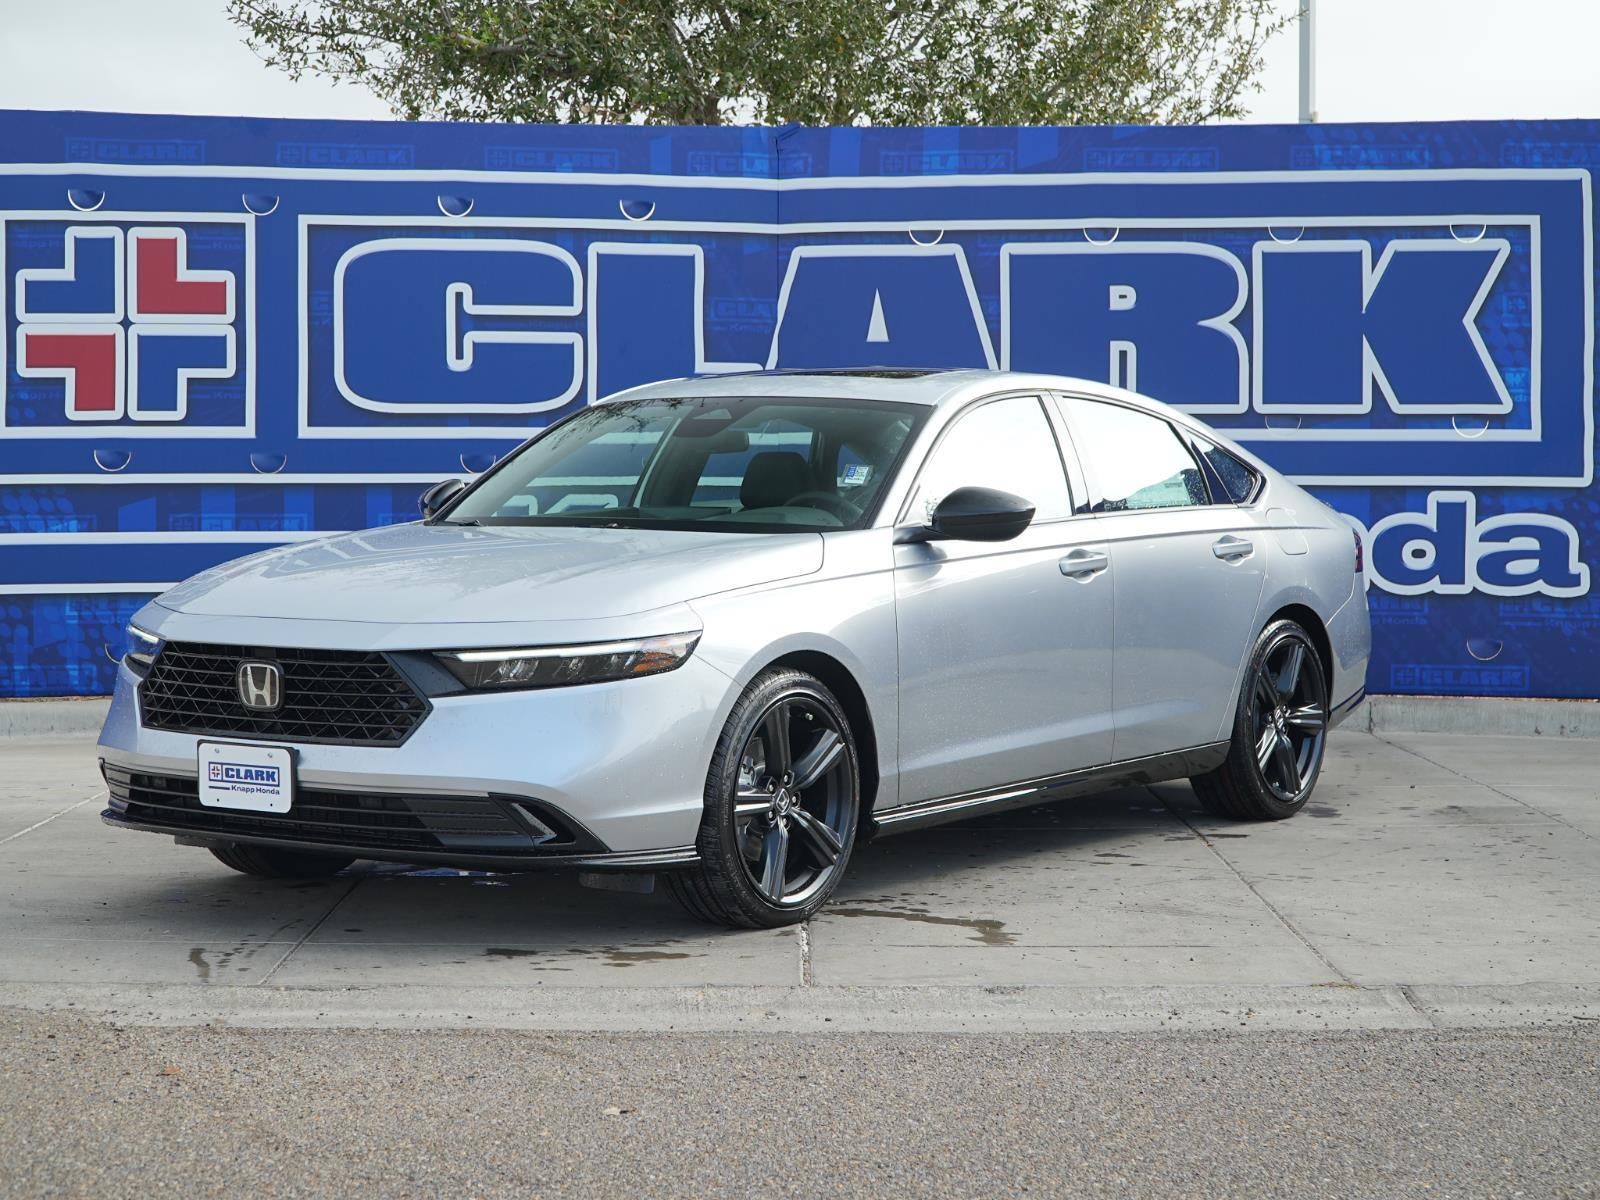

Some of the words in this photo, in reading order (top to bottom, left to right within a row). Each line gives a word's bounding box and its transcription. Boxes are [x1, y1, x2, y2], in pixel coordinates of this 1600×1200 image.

[334, 237, 1513, 414] CLARK
[1341, 490, 1590, 598] da
[1422, 670, 1522, 686] CLARK
[224, 767, 277, 782] CLARK
[231, 785, 255, 793] Knapp
[256, 786, 280, 795] Honda
